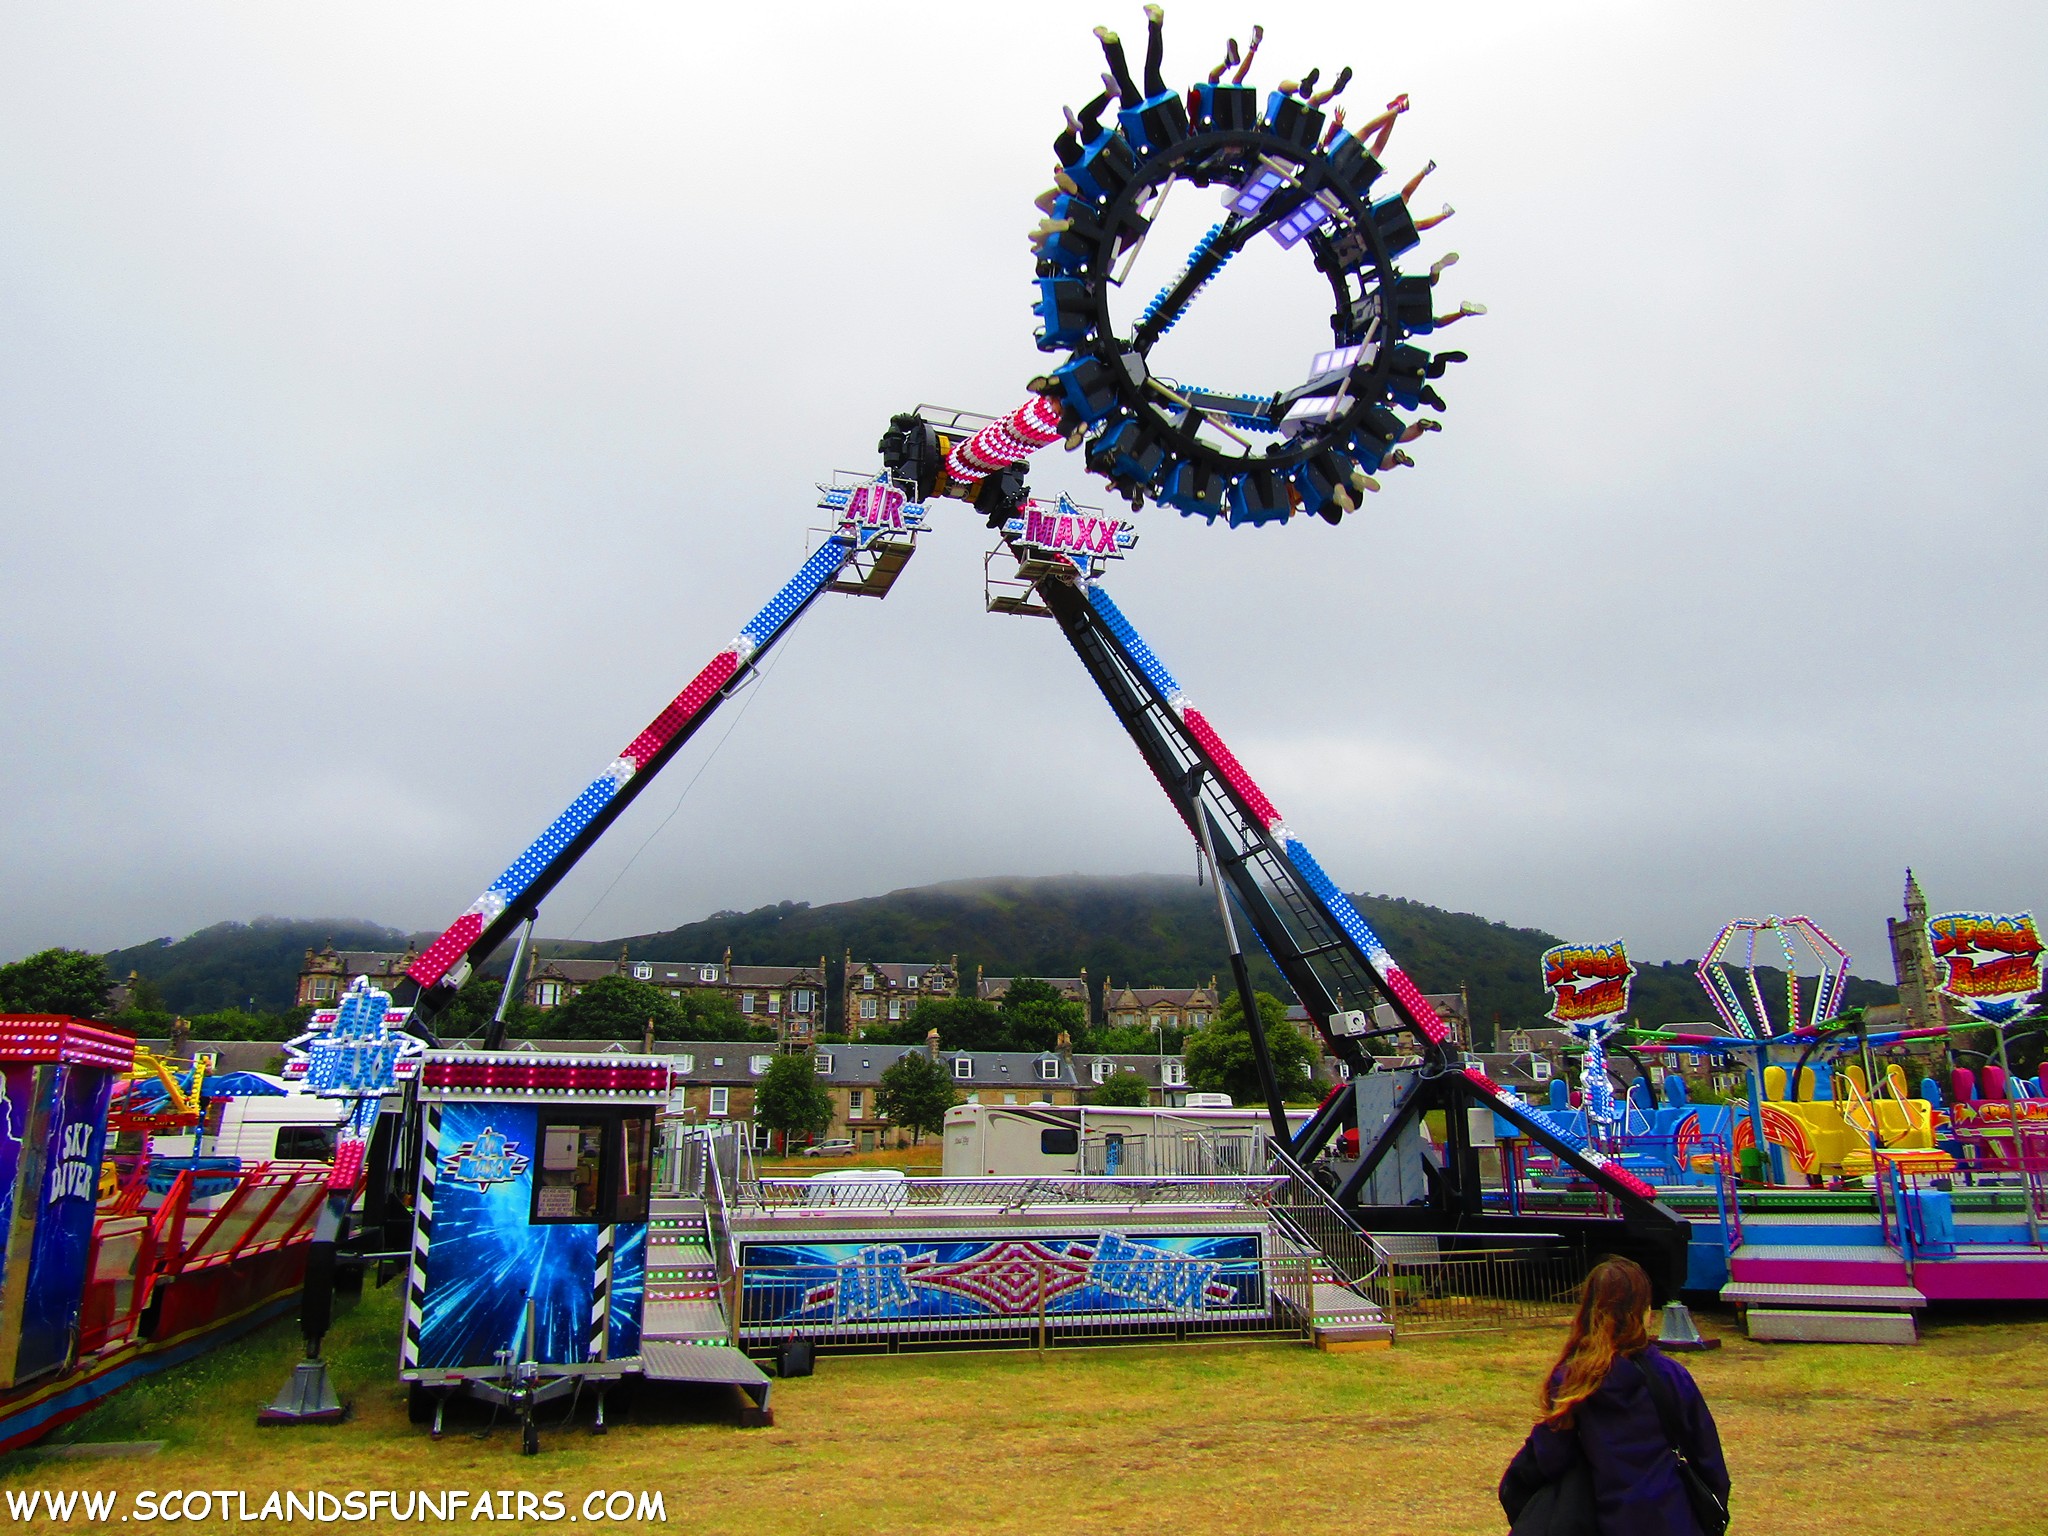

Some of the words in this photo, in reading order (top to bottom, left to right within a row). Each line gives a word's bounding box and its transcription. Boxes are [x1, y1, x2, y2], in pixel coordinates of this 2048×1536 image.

[845, 484, 904, 529] AIR
[1025, 509, 1119, 554] MAXX
[332, 992, 391, 1042] AIR
[303, 1043, 398, 1093] MAXX
[63, 1122, 93, 1159] SKY
[473, 1134, 505, 1156] AIR
[49, 1161, 93, 1203] DIVER
[457, 1157, 515, 1179] MAXX
[836, 1248, 912, 1321] AIR
[1090, 1233, 1217, 1312] MAXX
